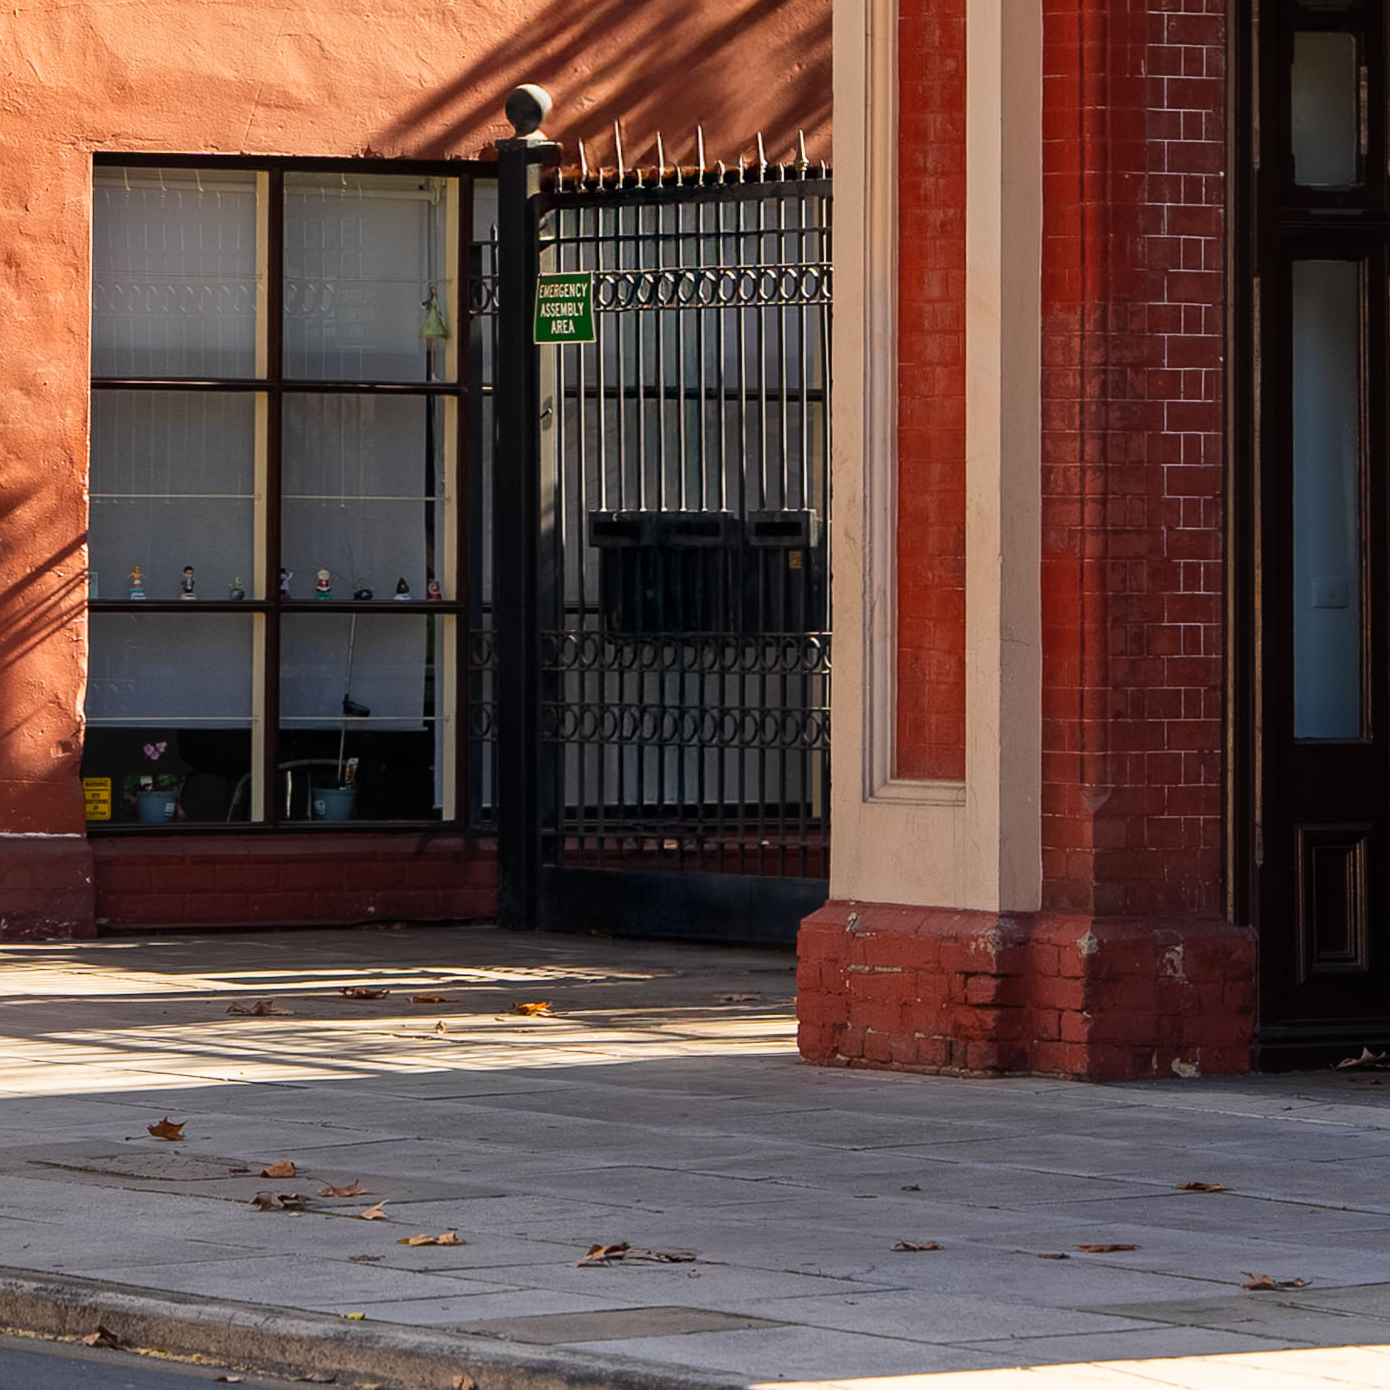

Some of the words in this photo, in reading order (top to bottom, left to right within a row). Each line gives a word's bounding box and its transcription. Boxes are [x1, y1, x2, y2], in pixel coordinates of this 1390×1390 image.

[539, 283, 588, 299] EMERGENCY
[540, 302, 584, 318] ASSEMBLY
[551, 319, 575, 334] AREA
